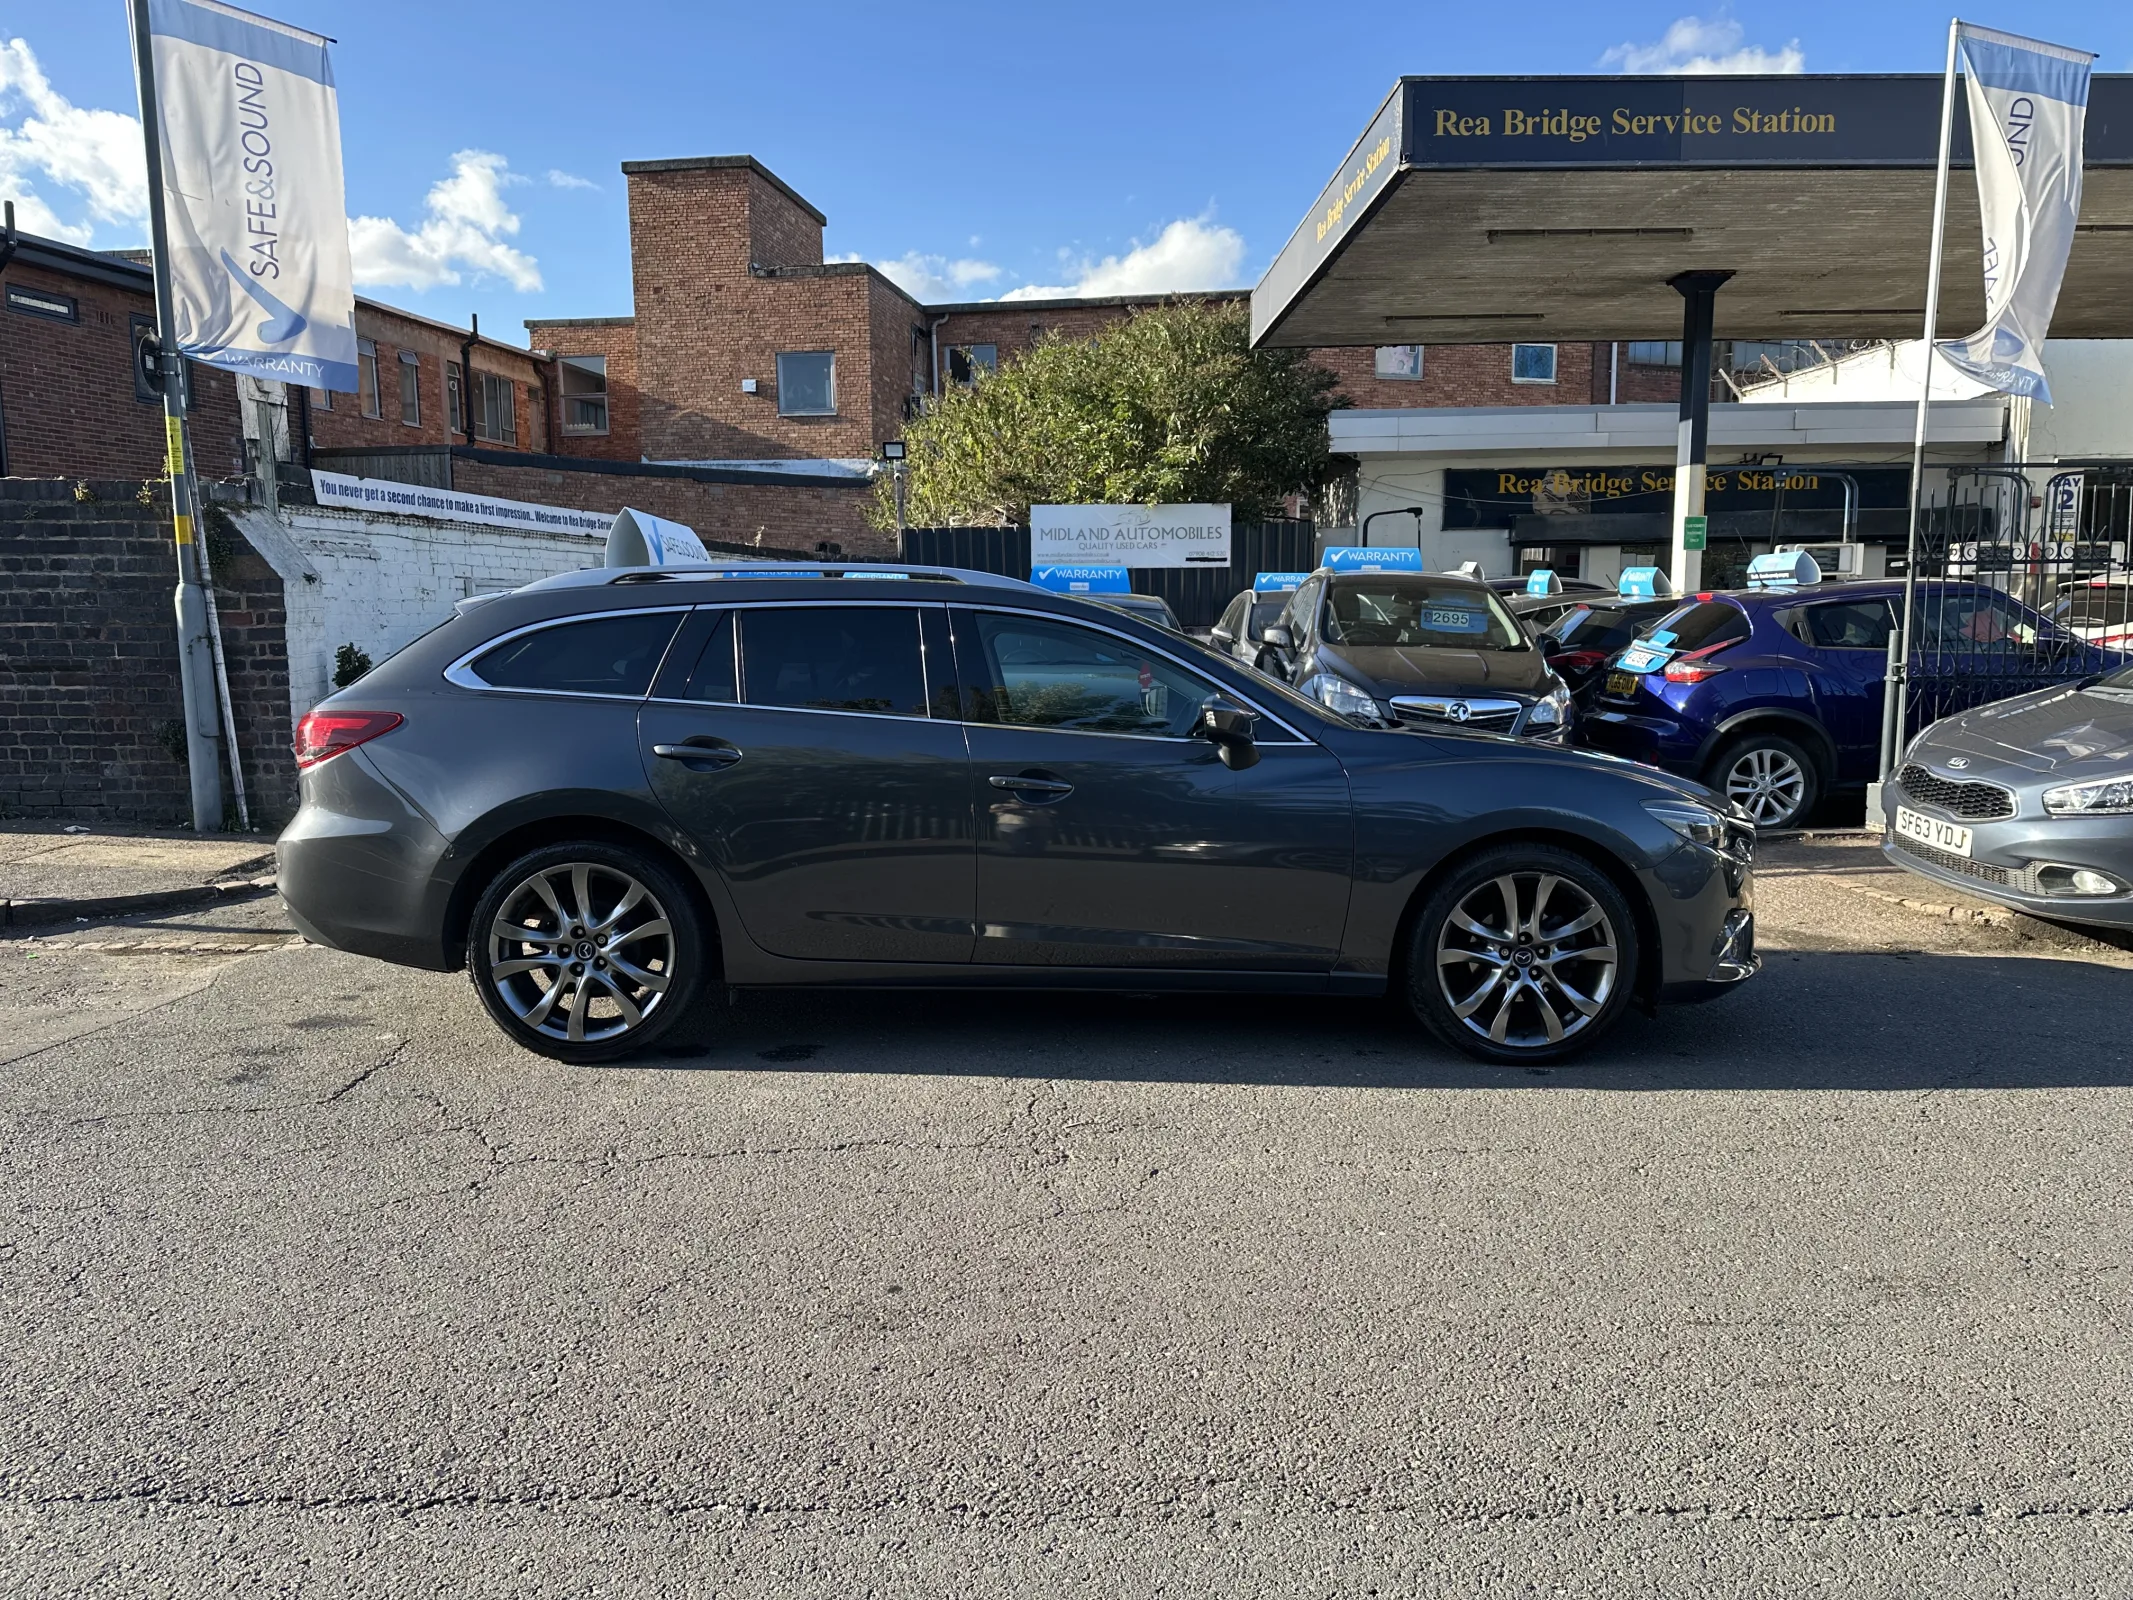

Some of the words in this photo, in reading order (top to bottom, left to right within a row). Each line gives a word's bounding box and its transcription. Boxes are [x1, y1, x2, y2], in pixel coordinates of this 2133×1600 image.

[1433, 109, 1491, 136] Rea
[1502, 108, 1601, 142] Bridge
[1612, 107, 1722, 135] Service
[1732, 106, 1836, 133] Station
[235, 62, 280, 279] SAFE&SOUND
[1316, 221, 1327, 244] Rea
[1327, 198, 1343, 231] Bridge
[1344, 168, 1366, 208] Service
[1366, 136, 1390, 179] Station
[225, 353, 324, 378] WARRANTY
[1497, 473, 1543, 493] Rea
[1554, 472, 1633, 497] Bridge
[1641, 471, 1727, 492] Serce
[1737, 471, 1818, 490] Staion
[320, 479, 337, 495] You
[338, 484, 363, 499] never
[365, 488, 379, 501] get
[380, 490, 386, 502] a
[387, 490, 416, 506] second
[417, 493, 445, 509] chance
[446, 498, 453, 510] to
[454, 500, 474, 514] make
[475, 503, 480, 514] a
[480, 502, 495, 516] first
[535, 510, 561, 525] Welcome
[562, 515, 568, 526] to
[569, 515, 579, 527] Rea
[580, 516, 597, 530] Bridge
[2058, 489, 2074, 510] 2
[1040, 527, 1110, 541] MIDLAND
[1114, 526, 1223, 541] AUTOMOBILES
[1078, 542, 1114, 550] QUALITY
[1116, 542, 1135, 550] USED
[1137, 542, 1158, 550] CARS
[1347, 551, 1415, 562] WARRANTY
[1055, 569, 1122, 579] WARRANTY
[1901, 811, 1931, 839] SF63
[1936, 822, 1965, 849] YDJ
